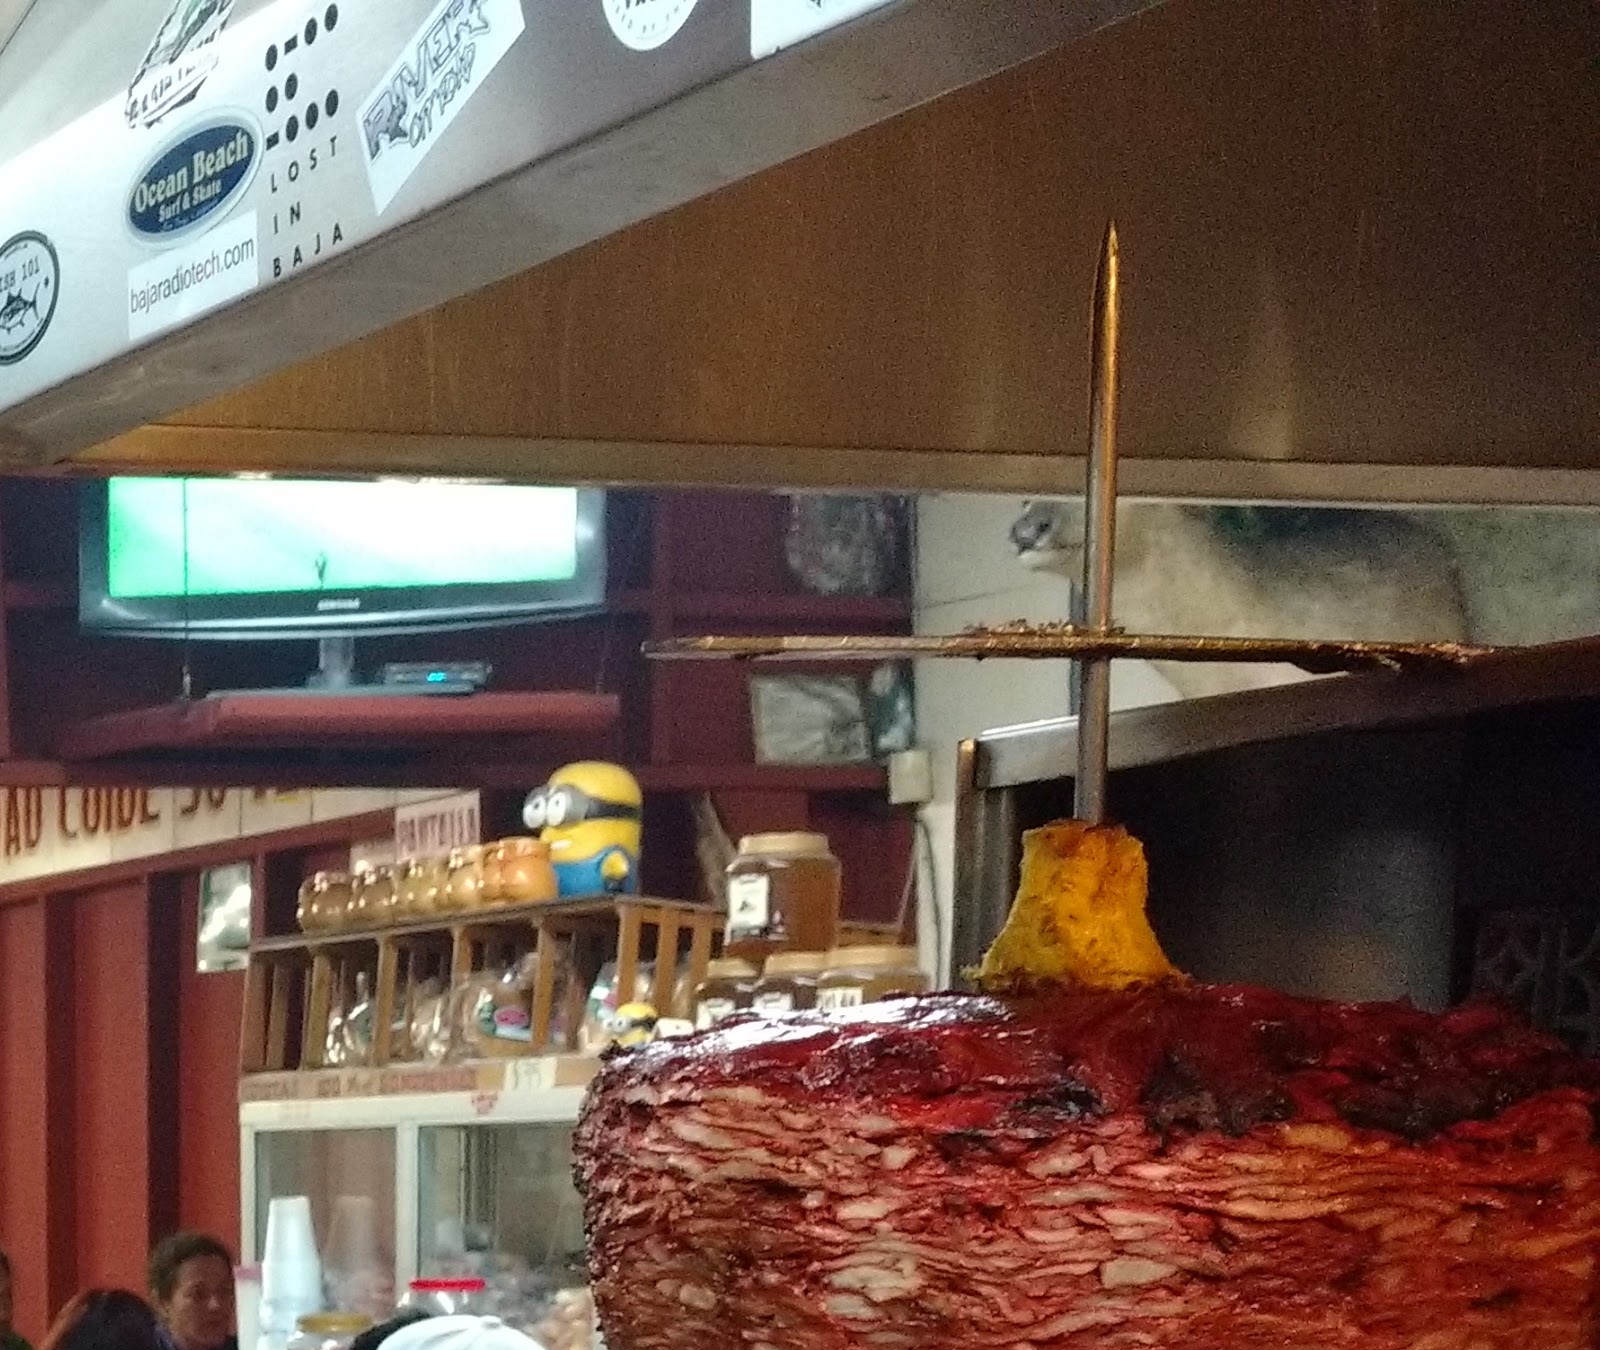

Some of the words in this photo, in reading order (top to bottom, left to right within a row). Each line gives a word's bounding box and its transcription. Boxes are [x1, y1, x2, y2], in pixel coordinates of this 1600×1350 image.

[361, 0, 491, 161] RIVER
[134, 166, 189, 214] Ocean
[192, 128, 250, 183] Beach
[270, 135, 338, 194] LOST
[158, 194, 183, 222] Surf
[181, 190, 191, 210] &
[192, 178, 222, 206] Skate
[273, 201, 302, 235] IN
[22, 255, 41, 281] 101
[130, 237, 255, 314] bajaradiotech.com
[273, 222, 344, 279] BAJA
